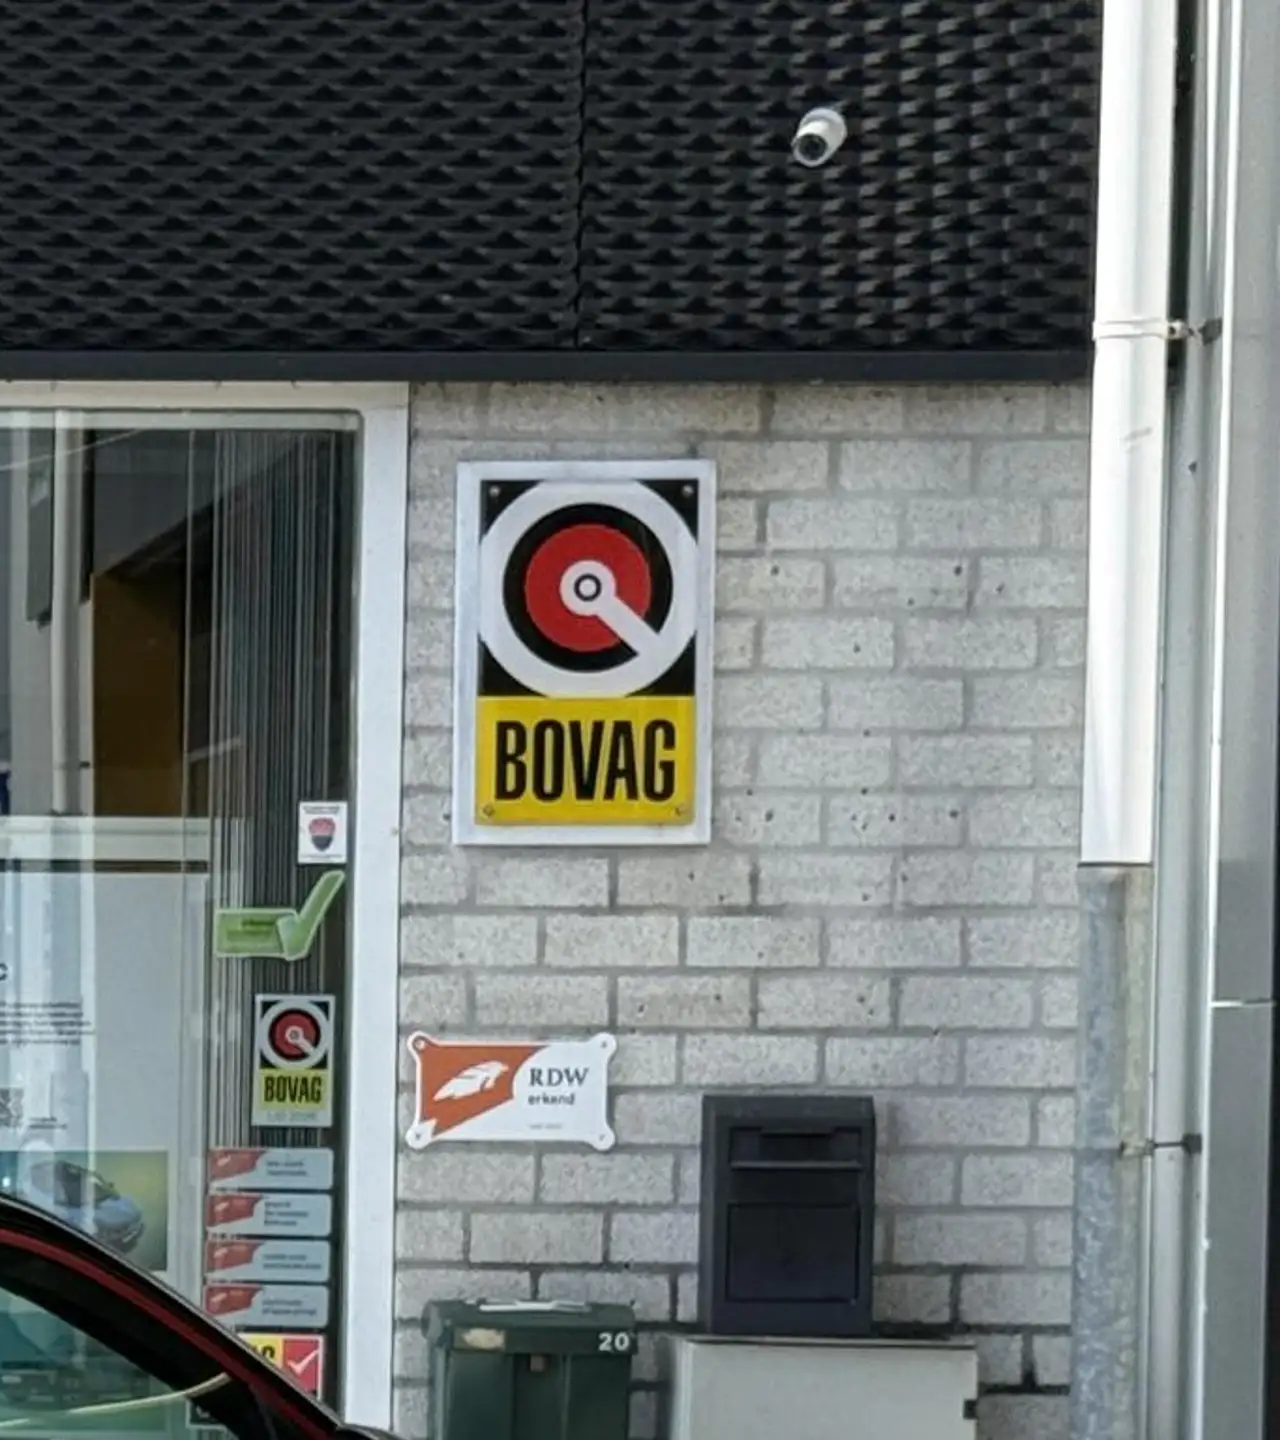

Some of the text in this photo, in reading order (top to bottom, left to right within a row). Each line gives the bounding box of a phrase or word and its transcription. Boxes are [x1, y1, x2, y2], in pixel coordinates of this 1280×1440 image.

[495, 718, 676, 802] BOVAG
[529, 1066, 590, 1088] RDW
[264, 1075, 323, 1104] BOVAG
[527, 1091, 576, 1106] erkend
[598, 1331, 630, 1351] 20
